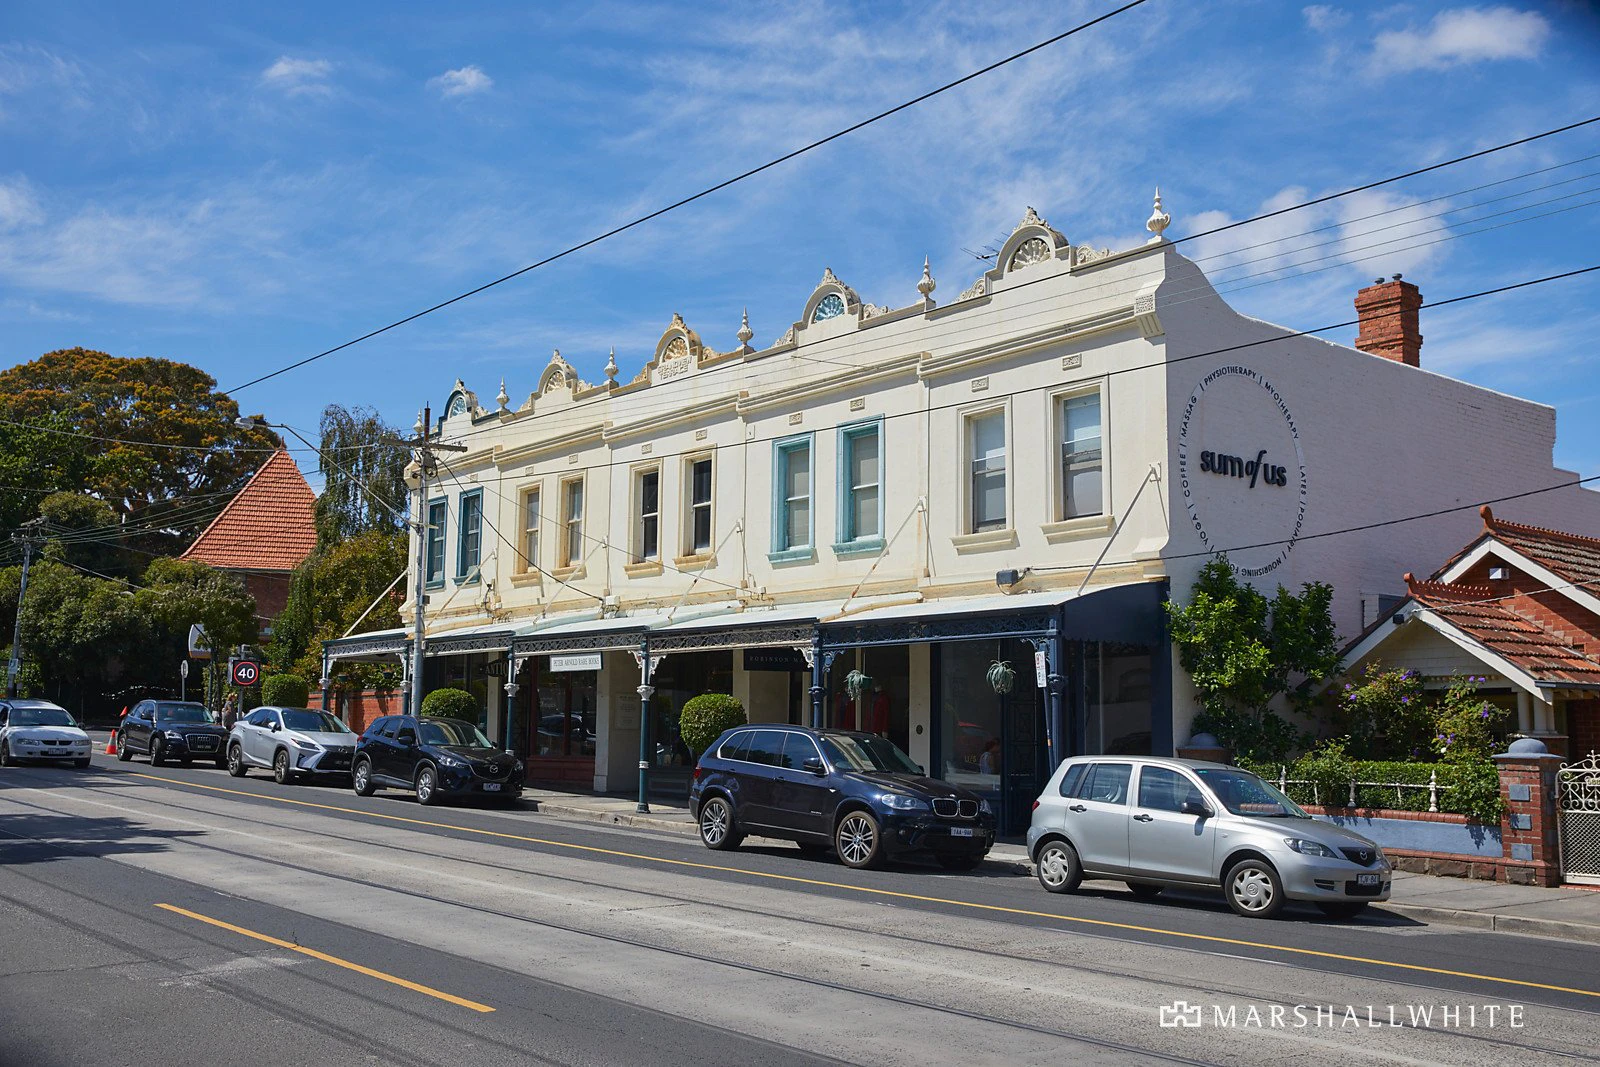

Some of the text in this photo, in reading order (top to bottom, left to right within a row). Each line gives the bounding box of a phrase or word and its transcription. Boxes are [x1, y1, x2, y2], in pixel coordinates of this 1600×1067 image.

[659, 364, 689, 380] TERRACE
[1203, 366, 1257, 386] PHYSIOTHERAPY
[1180, 395, 1197, 438] MASSAG
[1264, 381, 1299, 439] MYOTHERAPY
[1179, 453, 1191, 498] COFFEE
[1200, 450, 1244, 478] sum
[1263, 462, 1287, 487] us
[1299, 465, 1307, 496] LATES
[1192, 513, 1209, 545] YOGA
[1286, 506, 1305, 552] PODIATRY
[1241, 556, 1282, 577] NOURISHING
[237, 667, 255, 679] 40
